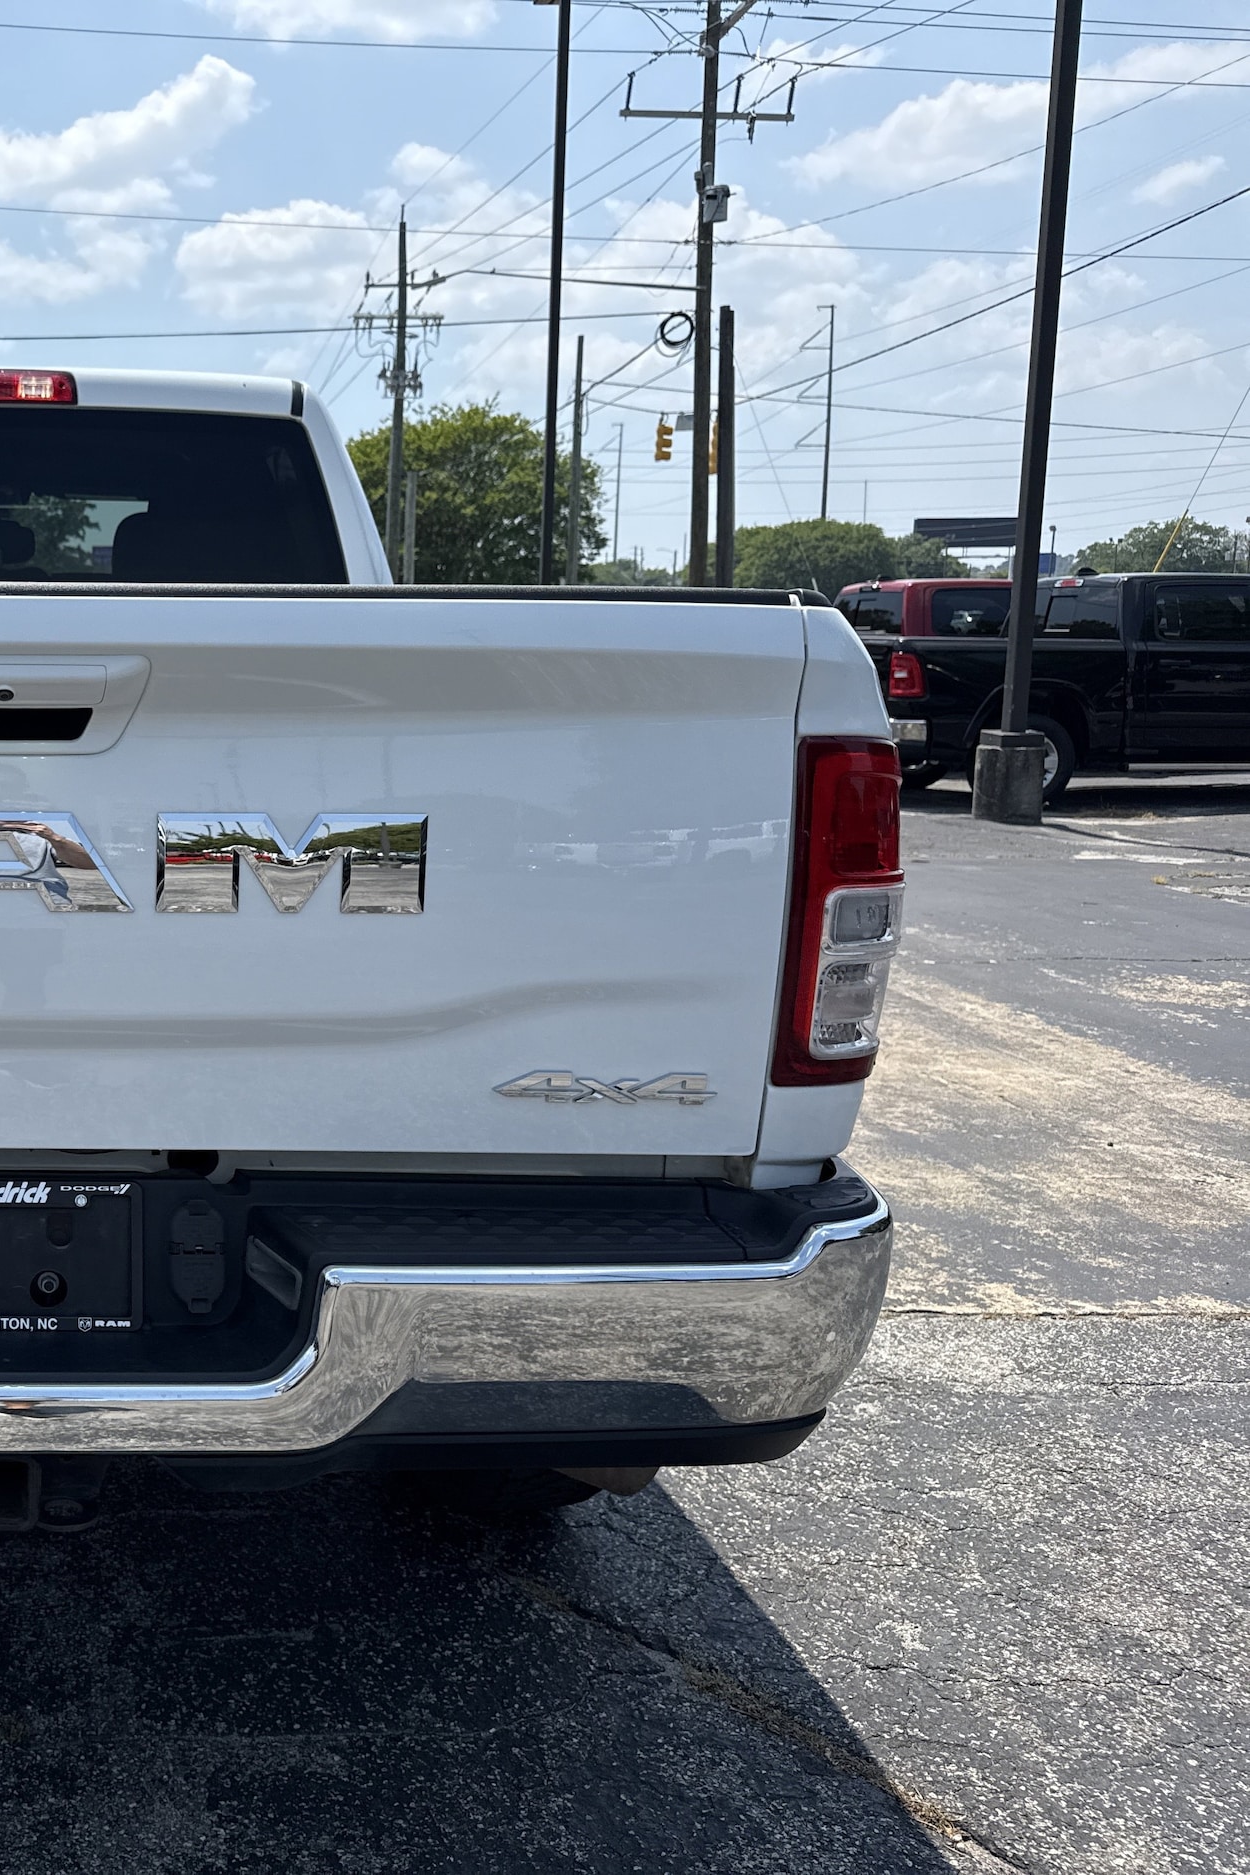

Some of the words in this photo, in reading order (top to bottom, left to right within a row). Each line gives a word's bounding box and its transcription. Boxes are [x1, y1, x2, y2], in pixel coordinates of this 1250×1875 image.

[60, 1184, 121, 1192] DODGE
[37, 1317, 58, 1330] NC
[94, 1319, 131, 1328] RAM
